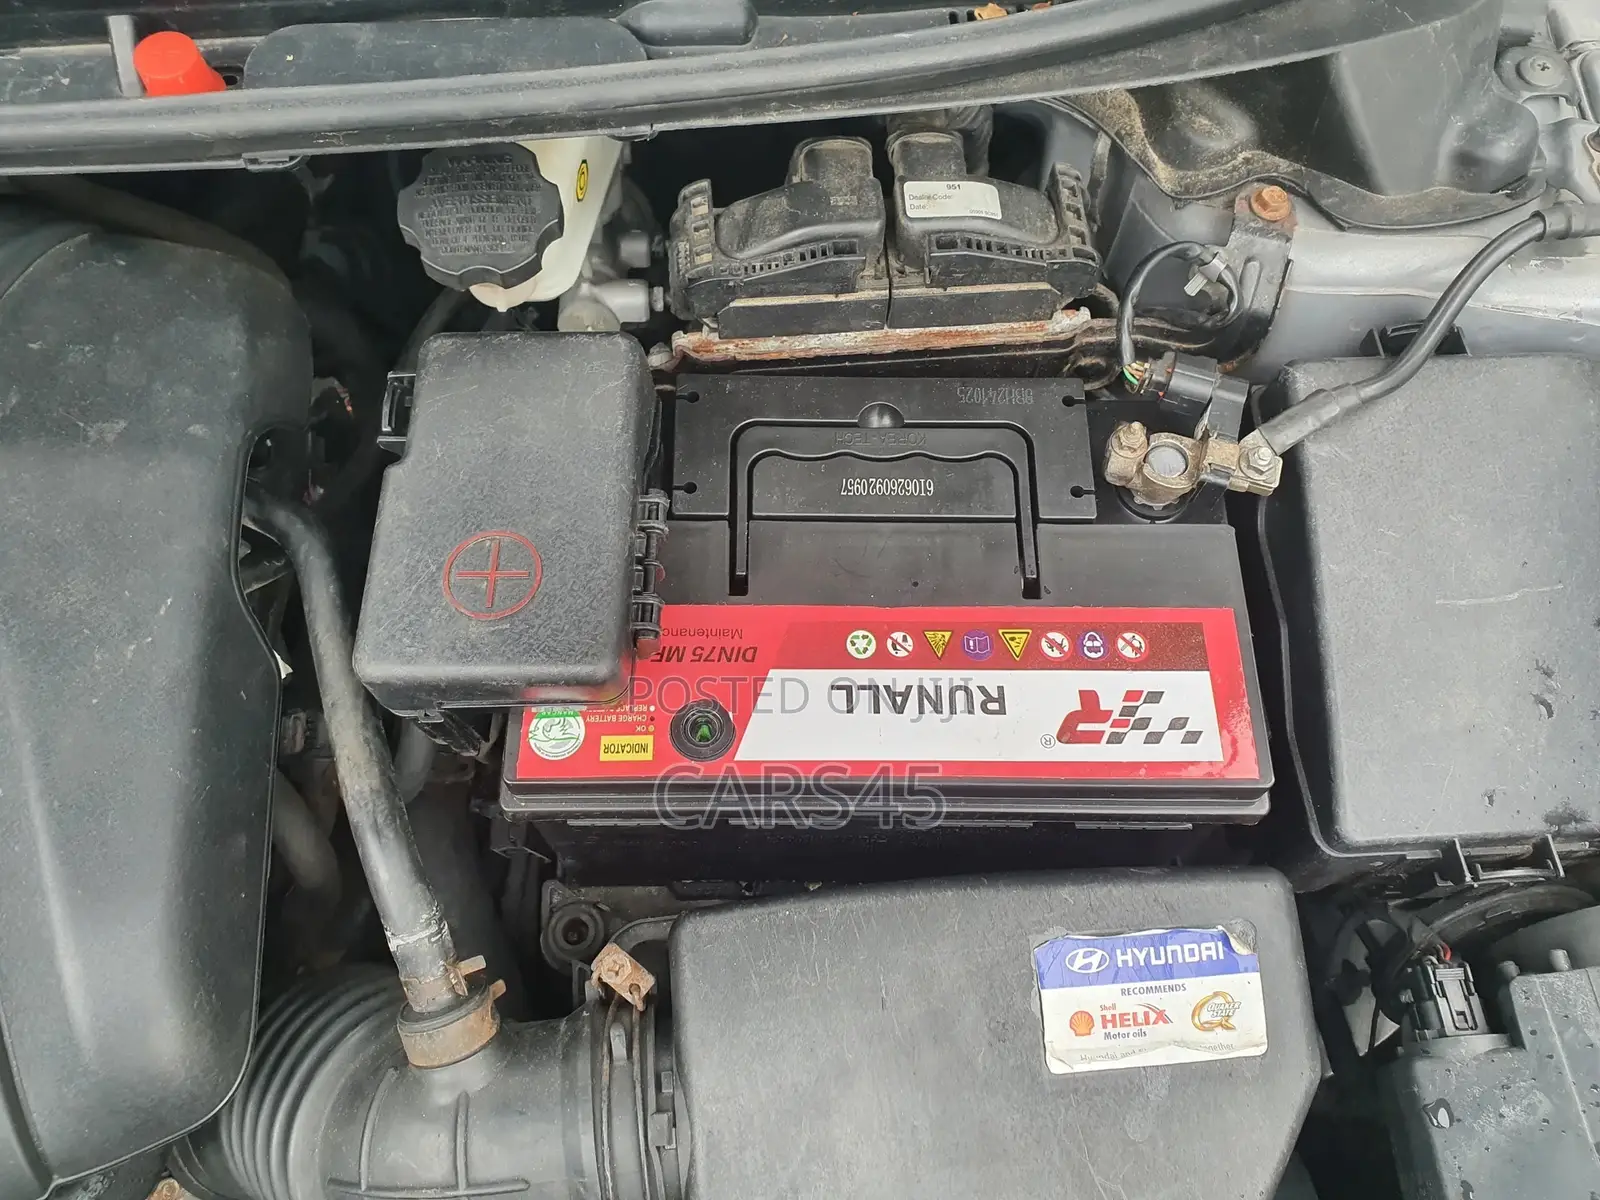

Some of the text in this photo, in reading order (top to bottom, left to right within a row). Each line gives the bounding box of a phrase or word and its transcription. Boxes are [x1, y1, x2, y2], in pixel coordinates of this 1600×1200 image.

[662, 628, 743, 640] Maintenanc
[690, 646, 758, 663] DIN75
[831, 684, 1007, 715] RUNALL
[586, 714, 647, 722] CHARGE BATTERY
[635, 724, 647, 732] OK
[603, 742, 649, 755] INDICATOR
[1116, 940, 1225, 968] HYUNDAI
[1120, 983, 1187, 997] RECOMMENDS
[1099, 1003, 1117, 1012] Shell
[1100, 1005, 1172, 1030] HELIX
[1103, 1028, 1147, 1041] Motor oils
